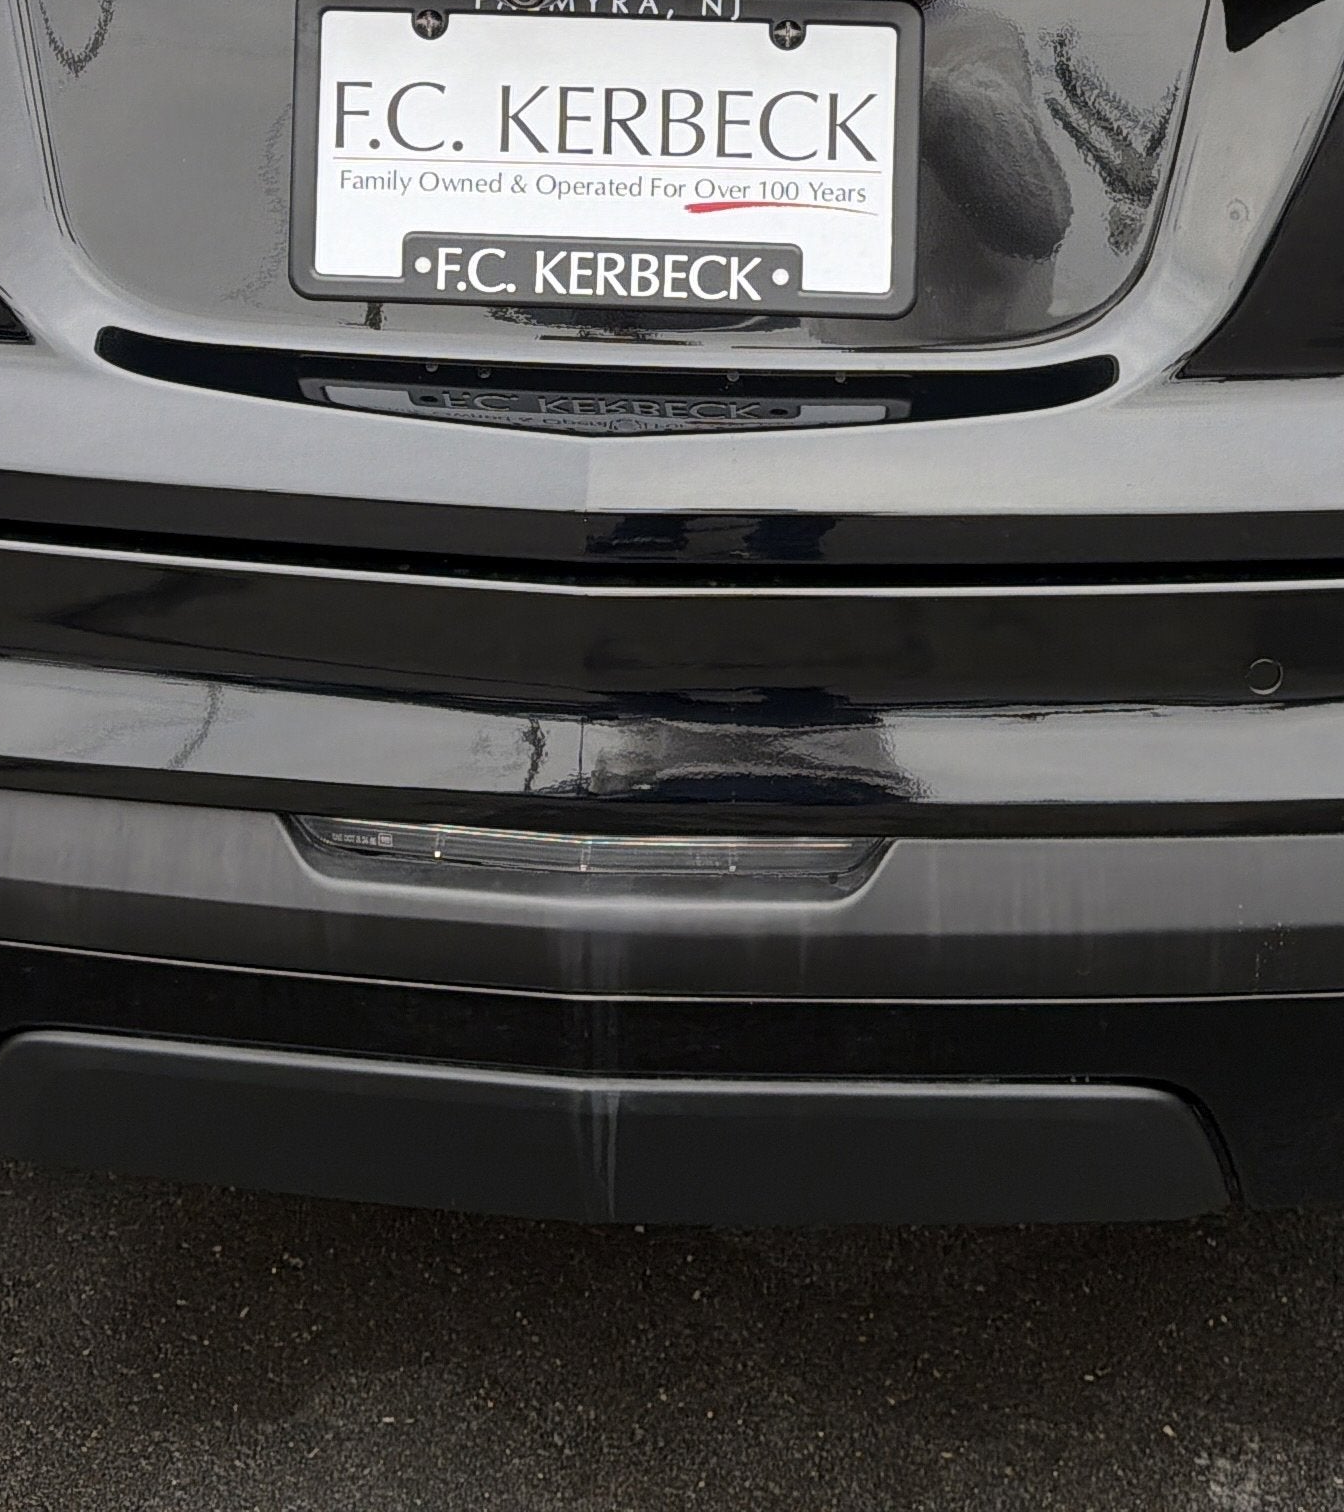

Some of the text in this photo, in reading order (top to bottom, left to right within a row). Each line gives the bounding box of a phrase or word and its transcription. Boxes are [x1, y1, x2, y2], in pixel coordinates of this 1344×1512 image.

[334, 81, 879, 163] F.C. KERBECK
[340, 170, 866, 203] Family Owned & Operated For Over 100 Years
[436, 247, 761, 302] F.C. KERBECK
